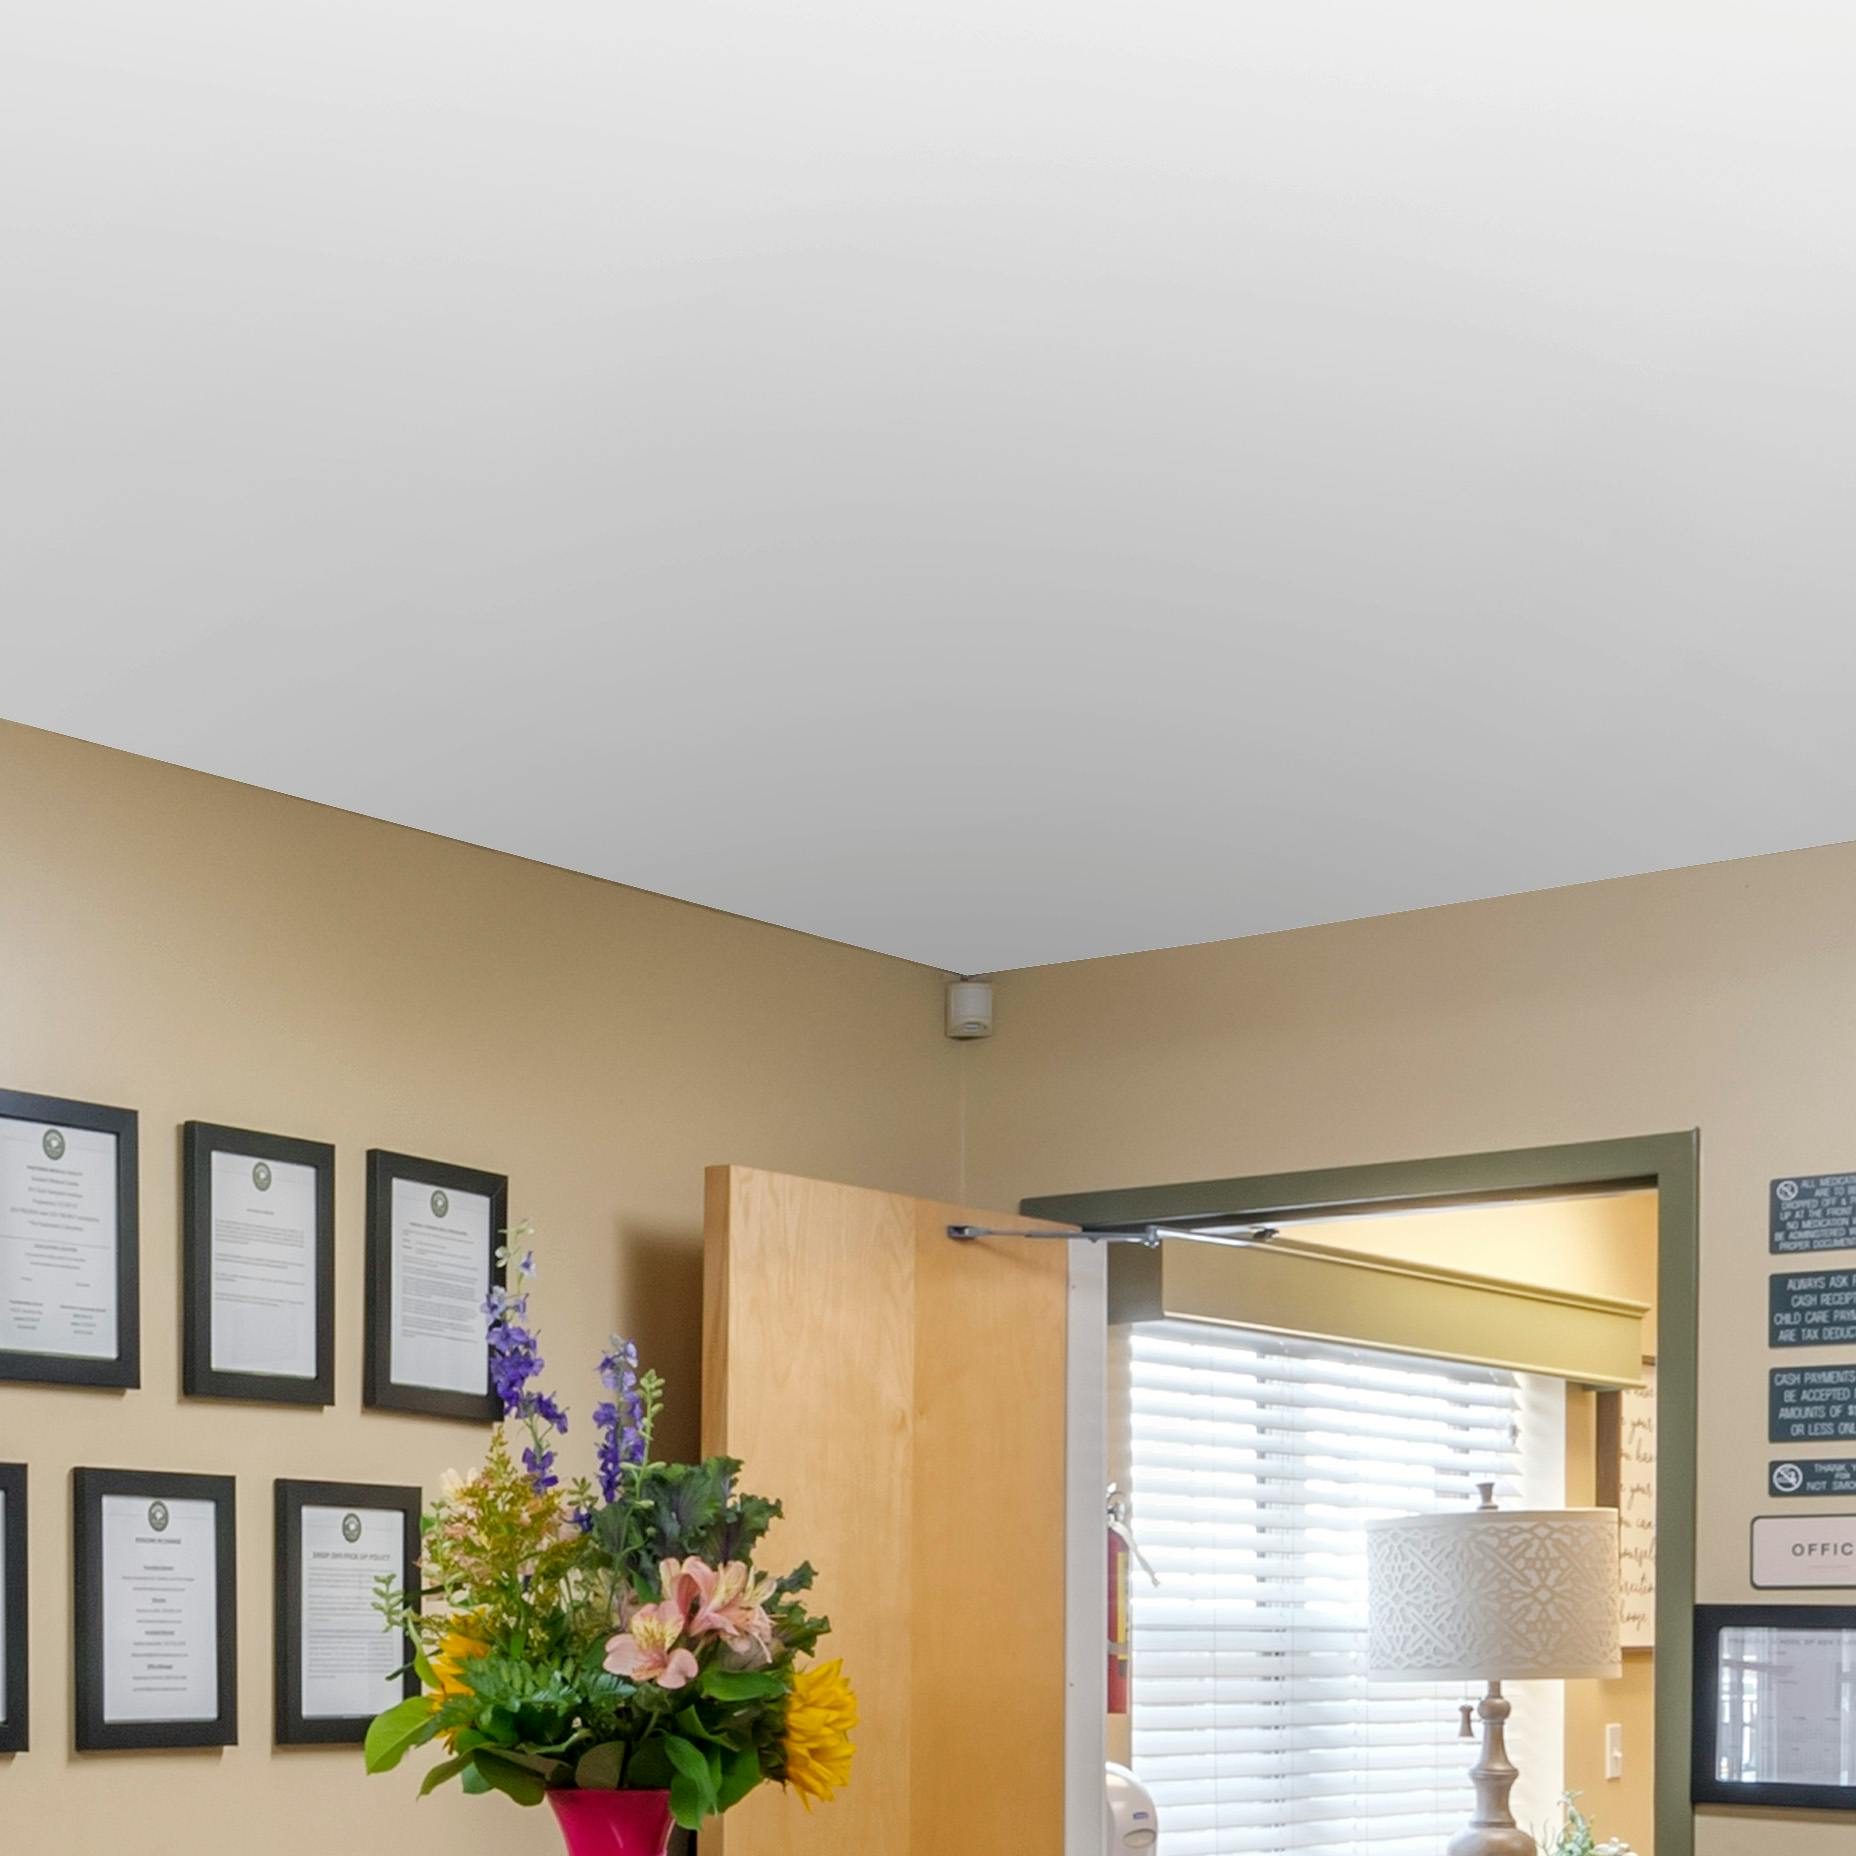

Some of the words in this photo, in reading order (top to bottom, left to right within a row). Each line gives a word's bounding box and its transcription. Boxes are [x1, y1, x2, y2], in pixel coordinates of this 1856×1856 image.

[1801, 1179, 1815, 1189] ALL
[1814, 1187, 1829, 1197] ARE
[1834, 1185, 1844, 1196] TO
[1781, 1199, 1819, 1211] DROPPED
[1821, 1197, 1836, 1208] OFF
[1779, 1210, 1792, 1221] UP
[1795, 1208, 1805, 1219] AT
[1808, 1207, 1822, 1218] THE
[1826, 1205, 1853, 1217] FRONT
[1786, 1220, 1799, 1231] NO
[1801, 1217, 1849, 1229] MEDICATION
[1774, 1231, 1785, 1242] BE
[1788, 1226, 1846, 1240] ADMINISTERED
[1779, 1240, 1810, 1251] PROPER
[1786, 1276, 1826, 1291] ALWAYS
[1829, 1274, 1849, 1289] ASK
[1791, 1294, 1817, 1308] CASH
[1773, 1311, 1802, 1326] CHILD
[1805, 1309, 1830, 1324] CARE
[1778, 1328, 1796, 1342] ARE
[1801, 1327, 1819, 1341] TAX
[1774, 1372, 1801, 1386] CASH
[1804, 1370, 1856, 1384] PAYMENTS
[1783, 1389, 1797, 1403] BE
[1801, 1387, 1851, 1401] ACCEPTED
[1778, 1405, 1826, 1419] AMOUNTS
[1829, 1404, 1843, 1418] OF
[1790, 1423, 1805, 1437] OR
[1808, 1422, 1834, 1436] LESS
[1814, 1463, 1846, 1473] THANK
[1805, 1481, 1827, 1491] NOT
